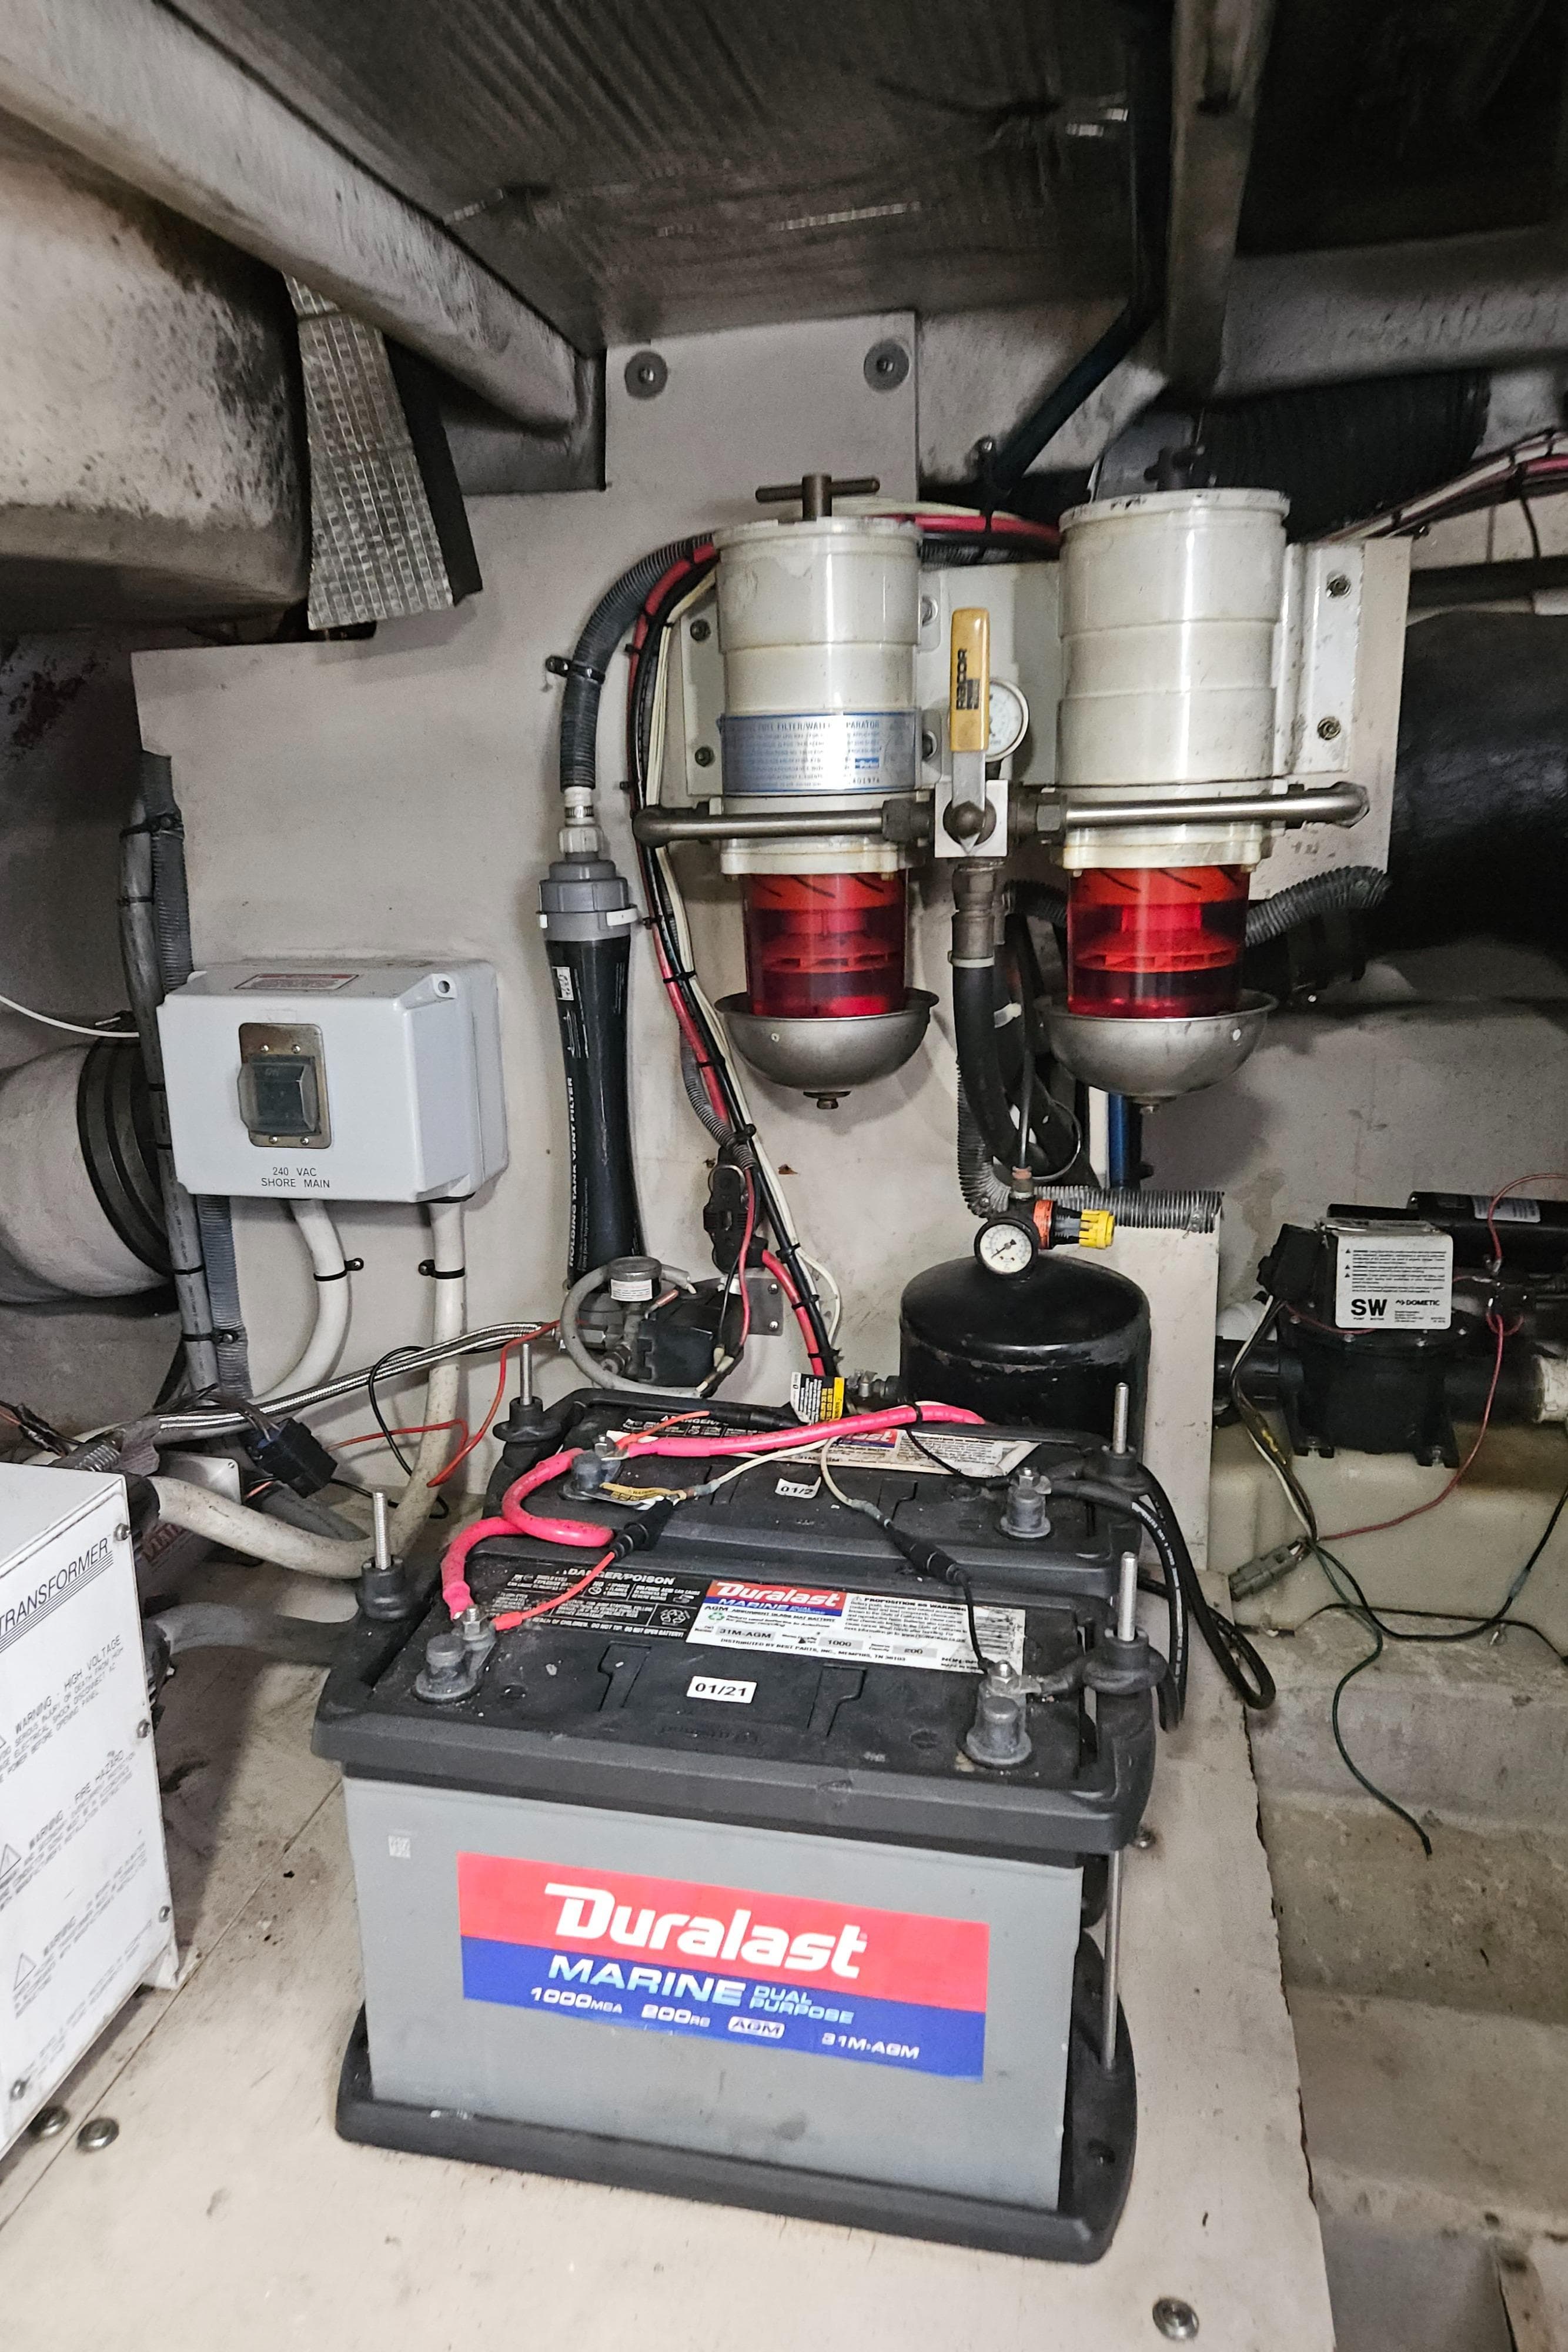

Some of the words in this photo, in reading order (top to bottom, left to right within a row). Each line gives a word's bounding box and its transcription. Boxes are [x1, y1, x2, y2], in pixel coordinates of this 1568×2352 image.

[261, 1178, 296, 1187] SHORE
[304, 1179, 330, 1188] MAIN
[273, 1167, 289, 1176] 240
[296, 1167, 317, 1177] VAC
[569, 1204, 577, 1267] HOLDING
[1350, 1298, 1388, 1317] SW
[716, 1582, 841, 1607] Duralast
[718, 1598, 790, 1612] MARINE
[86, 1635, 121, 1671] VOLTAGE
[695, 1683, 747, 1697] 01/21
[544, 1882, 868, 1979] Duralast
[548, 1955, 746, 2007] MARINE
[753, 1985, 812, 2006] DUAL
[749, 1996, 854, 2024] PURPOSE
